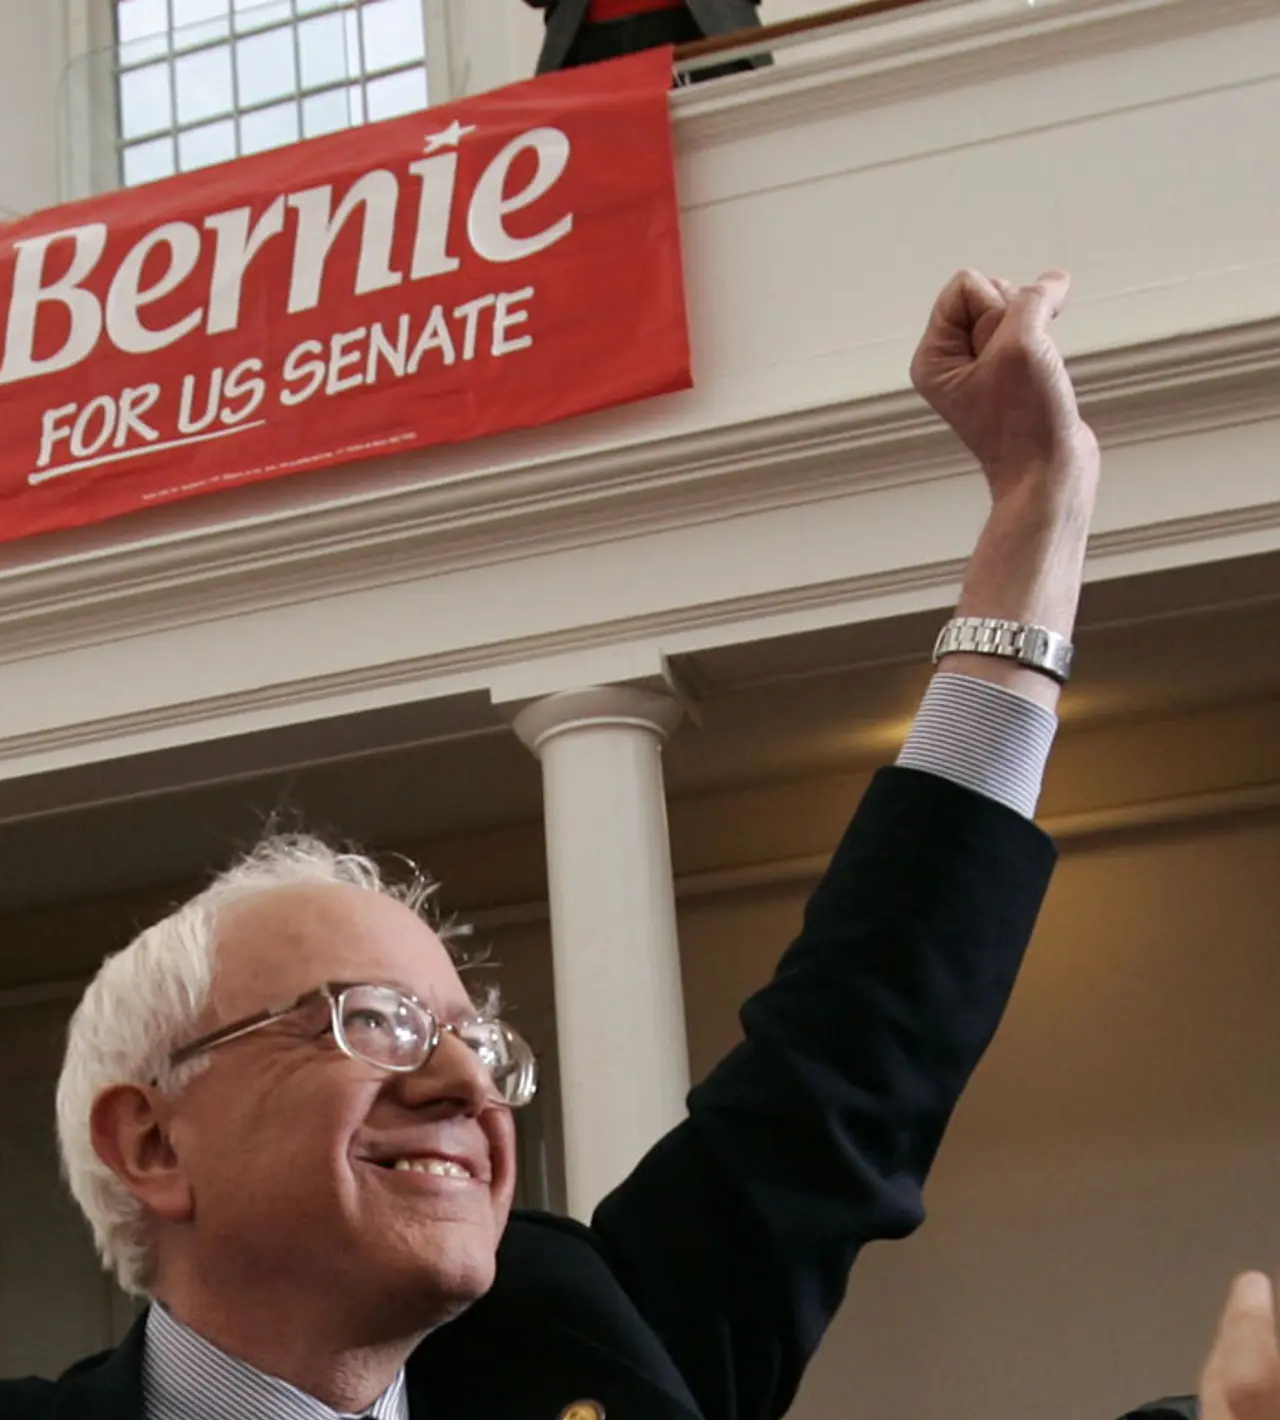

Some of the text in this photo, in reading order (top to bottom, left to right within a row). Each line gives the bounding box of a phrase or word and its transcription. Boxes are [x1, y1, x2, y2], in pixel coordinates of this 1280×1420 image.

[34, 383, 161, 468] FOR
[177, 357, 267, 434] US
[279, 285, 535, 406] SENATE
